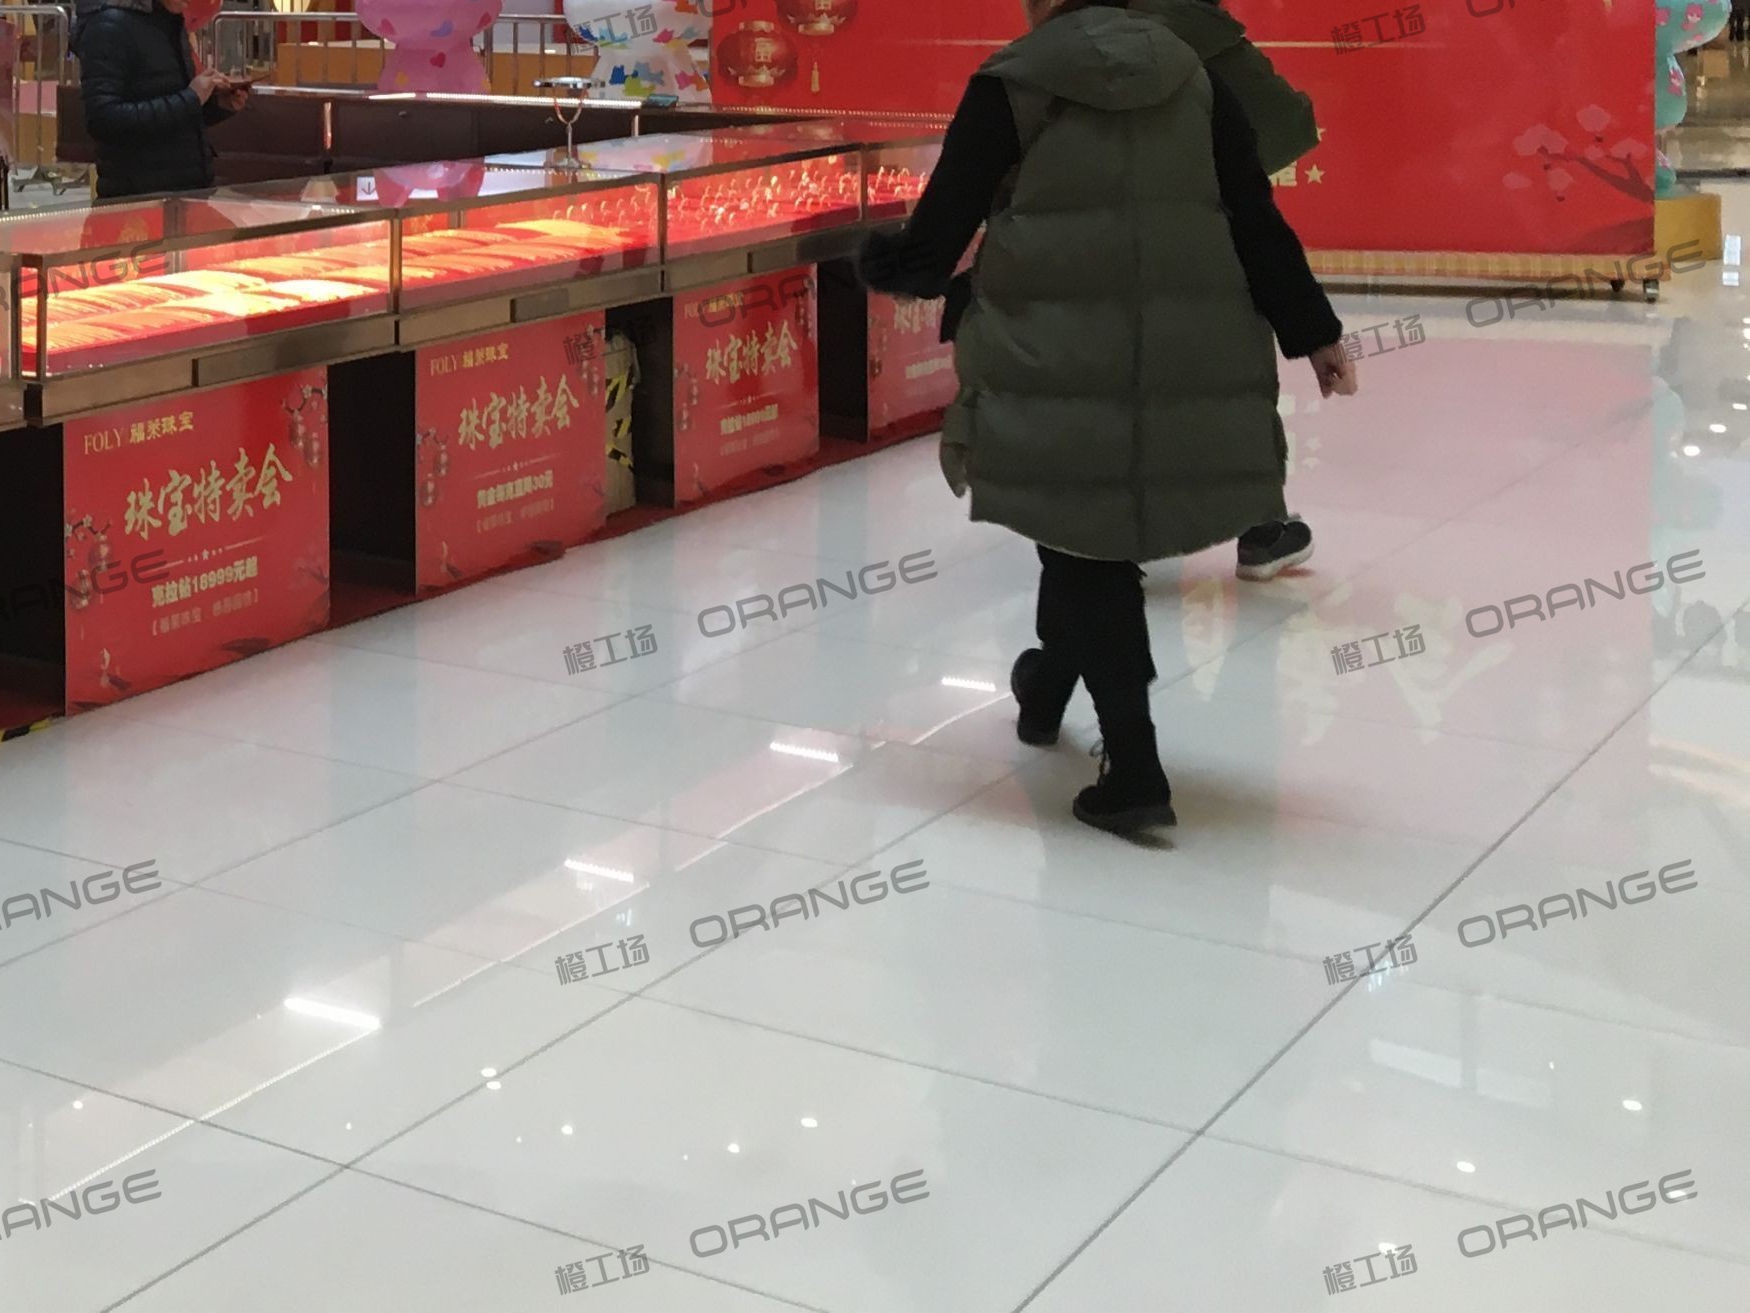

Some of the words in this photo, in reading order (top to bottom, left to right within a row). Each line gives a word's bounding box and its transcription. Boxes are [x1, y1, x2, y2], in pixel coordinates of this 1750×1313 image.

[705, 318, 799, 386] 珠宝特卖会
[83, 429, 123, 455] FOLY
[130, 411, 194, 444] 福莱珠宝
[458, 374, 580, 452] 珠宝特卖会
[123, 443, 293, 541] 珠宝特卖会
